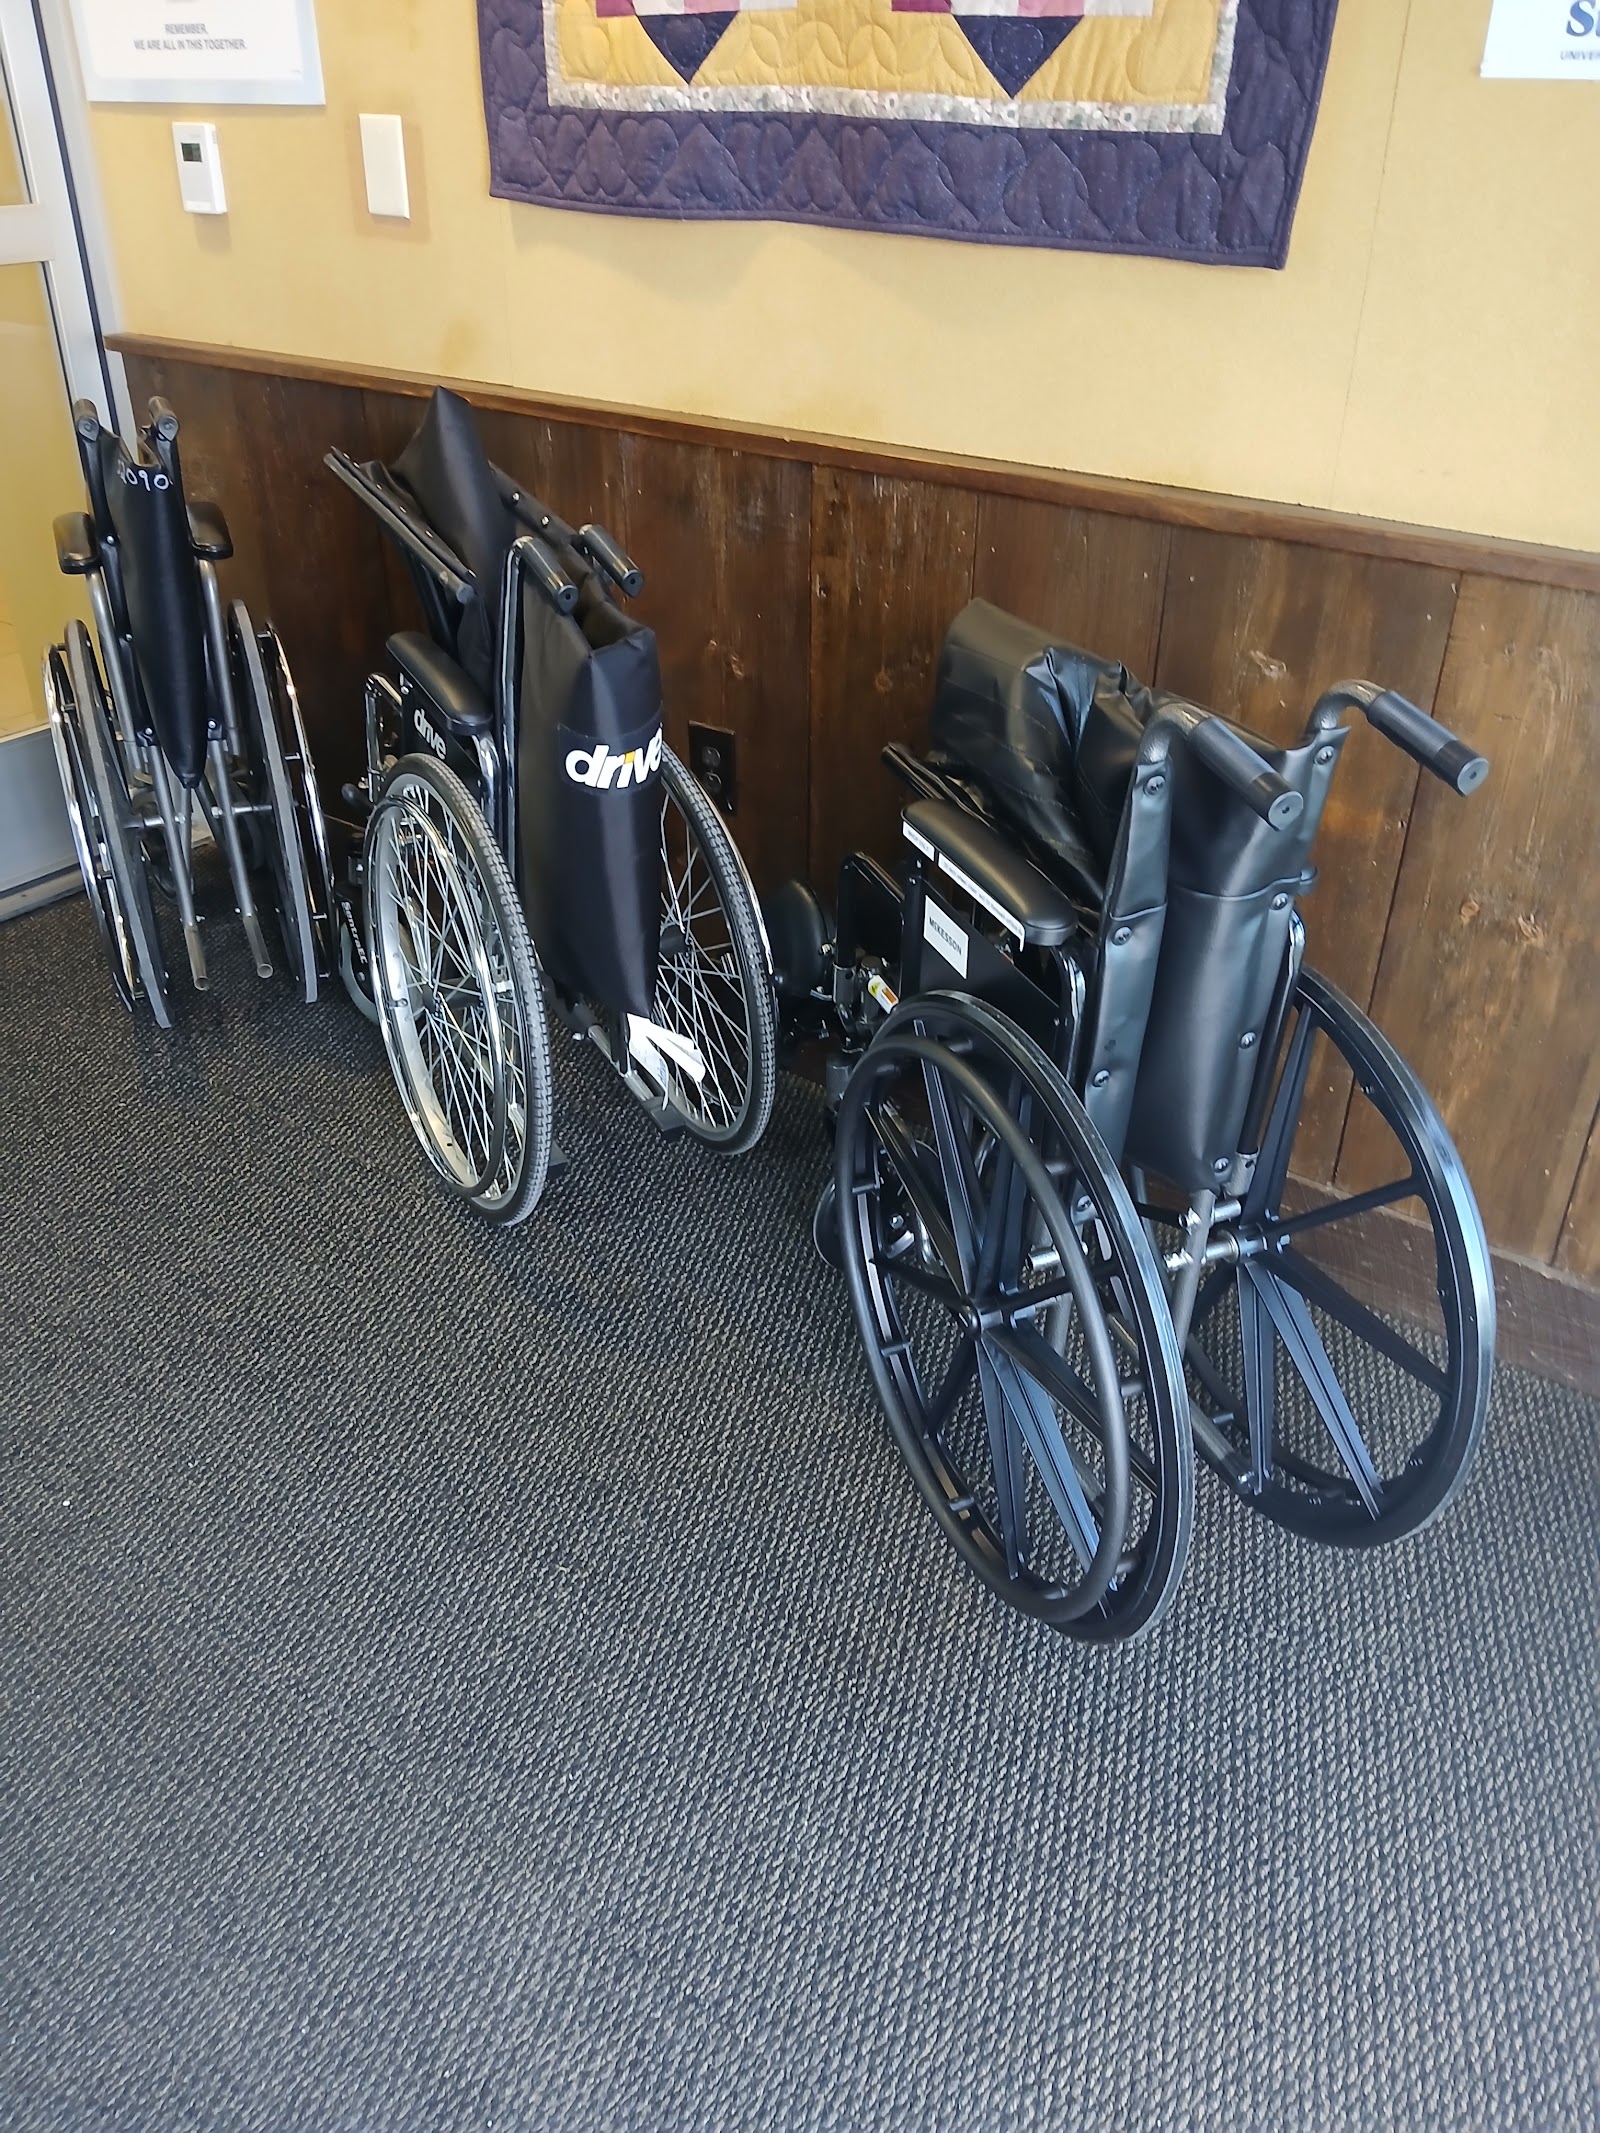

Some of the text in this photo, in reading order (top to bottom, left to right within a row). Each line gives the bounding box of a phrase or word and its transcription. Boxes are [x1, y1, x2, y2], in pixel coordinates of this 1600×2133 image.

[1566, 0, 1600, 37] S
[133, 40, 145, 50] WE
[147, 40, 161, 50] ARE
[163, 39, 177, 50] ALL
[178, 40, 185, 50] IN
[185, 39, 203, 50] THIS
[413, 708, 447, 760] drive
[565, 728, 663, 789] drive
